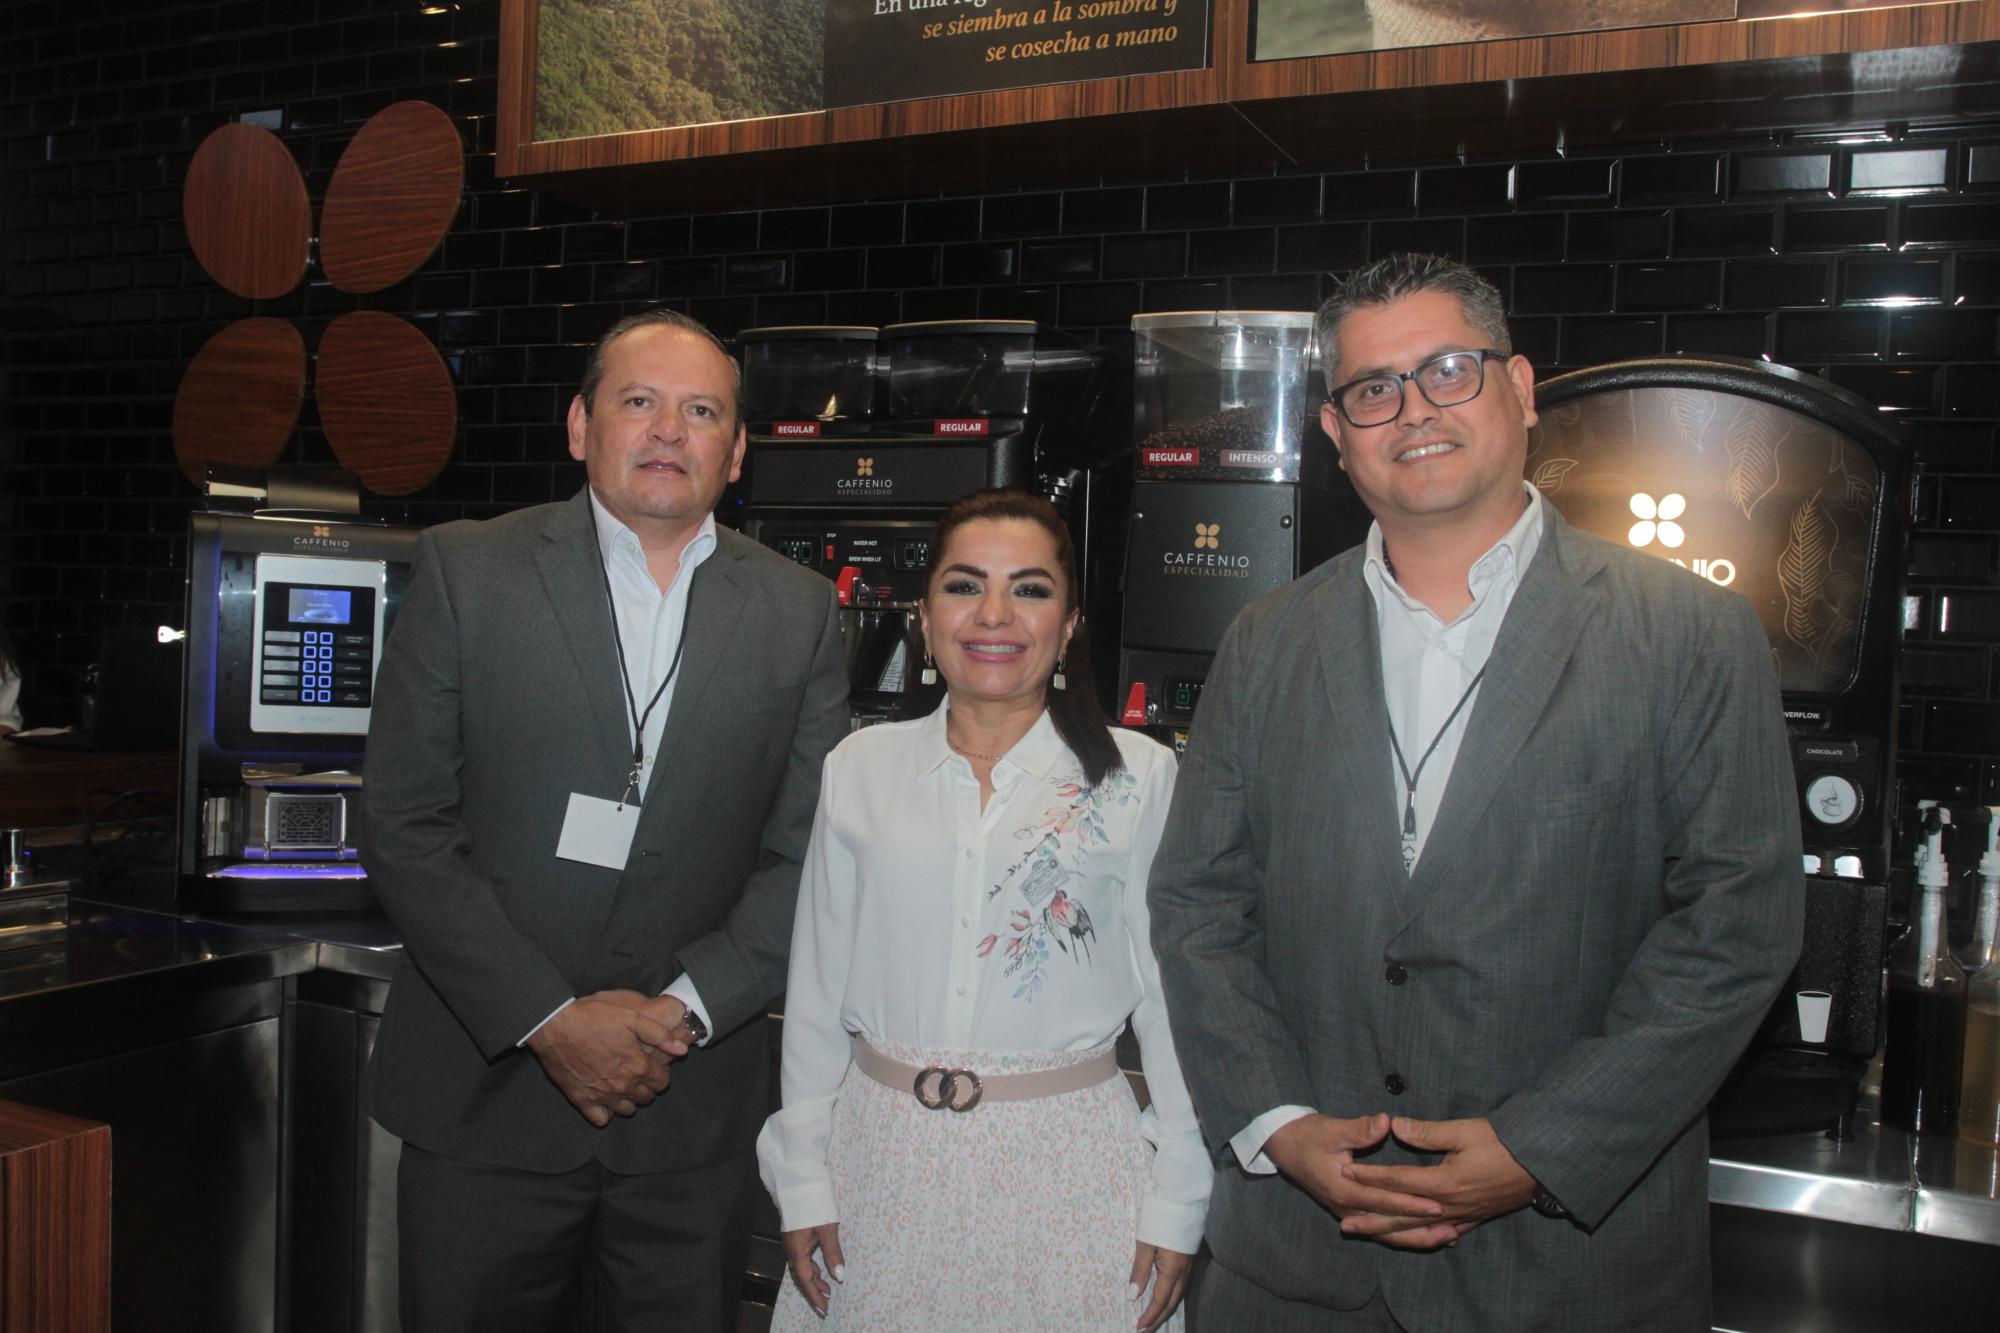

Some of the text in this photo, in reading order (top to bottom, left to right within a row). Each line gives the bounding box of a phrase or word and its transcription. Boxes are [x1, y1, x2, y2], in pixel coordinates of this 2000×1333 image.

[874, 0, 902, 15] En
[922, 0, 1178, 39] se siembra a la sombra y
[985, 25, 1178, 62] se cosecha a mano
[778, 425, 815, 434] REGULAR
[940, 423, 982, 432] REGULAR
[1149, 452, 1193, 462] REGULAR
[1229, 452, 1277, 464] INTENSO
[837, 479, 893, 488] CAFFENIO
[293, 537, 350, 548] CAFFENIO
[1164, 552, 1249, 568] CAFFENIO
[1164, 566, 1248, 578] ESPECIALIDAD
[1806, 748, 1843, 757] CHOCOLATE
